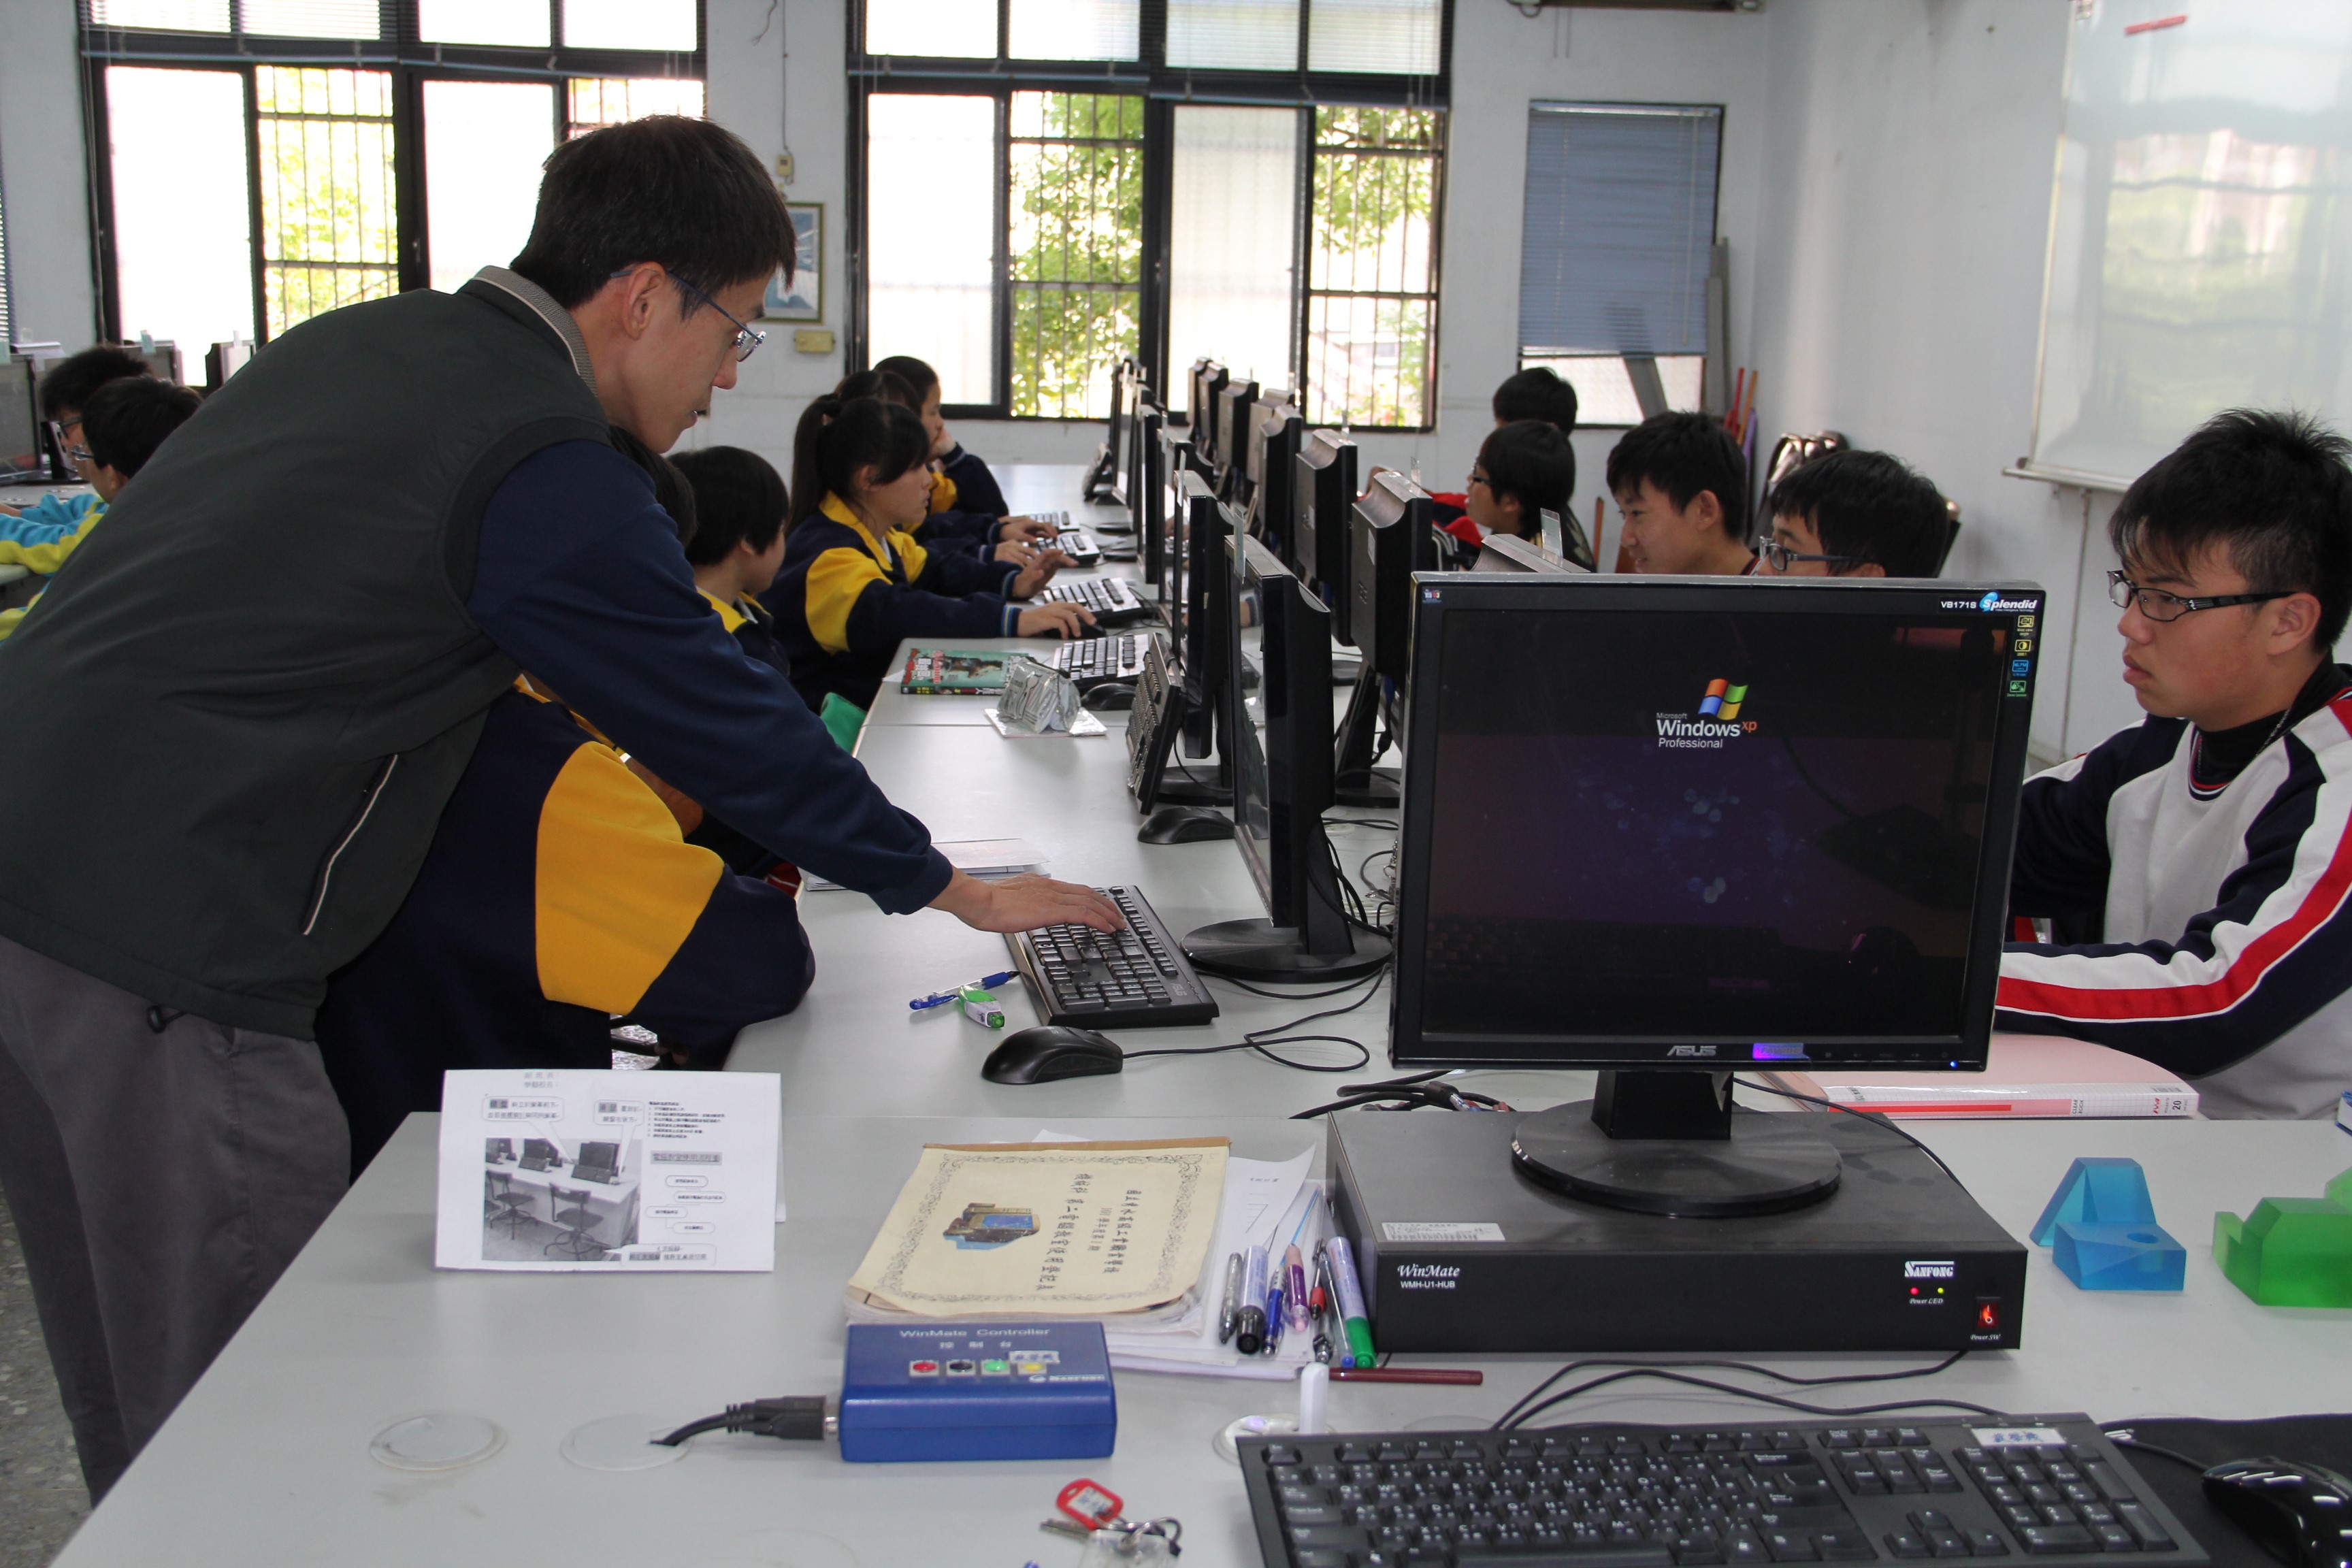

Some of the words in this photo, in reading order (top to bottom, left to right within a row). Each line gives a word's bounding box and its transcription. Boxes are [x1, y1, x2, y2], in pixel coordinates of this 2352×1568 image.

[1941, 601, 1977, 609] VB171S
[1982, 598, 2038, 611] Splendid
[1656, 719, 1741, 737] Windows
[1741, 721, 1758, 734] xp
[1659, 737, 1724, 749] Professional
[1667, 1045, 1717, 1056] ASUS
[2172, 1100, 2182, 1111] 20
[1397, 1262, 1460, 1277] WinMate
[1400, 1280, 1456, 1289] WMH-U1-HUB
[900, 1329, 967, 1338] WinMate
[977, 1328, 1050, 1337] Controller
